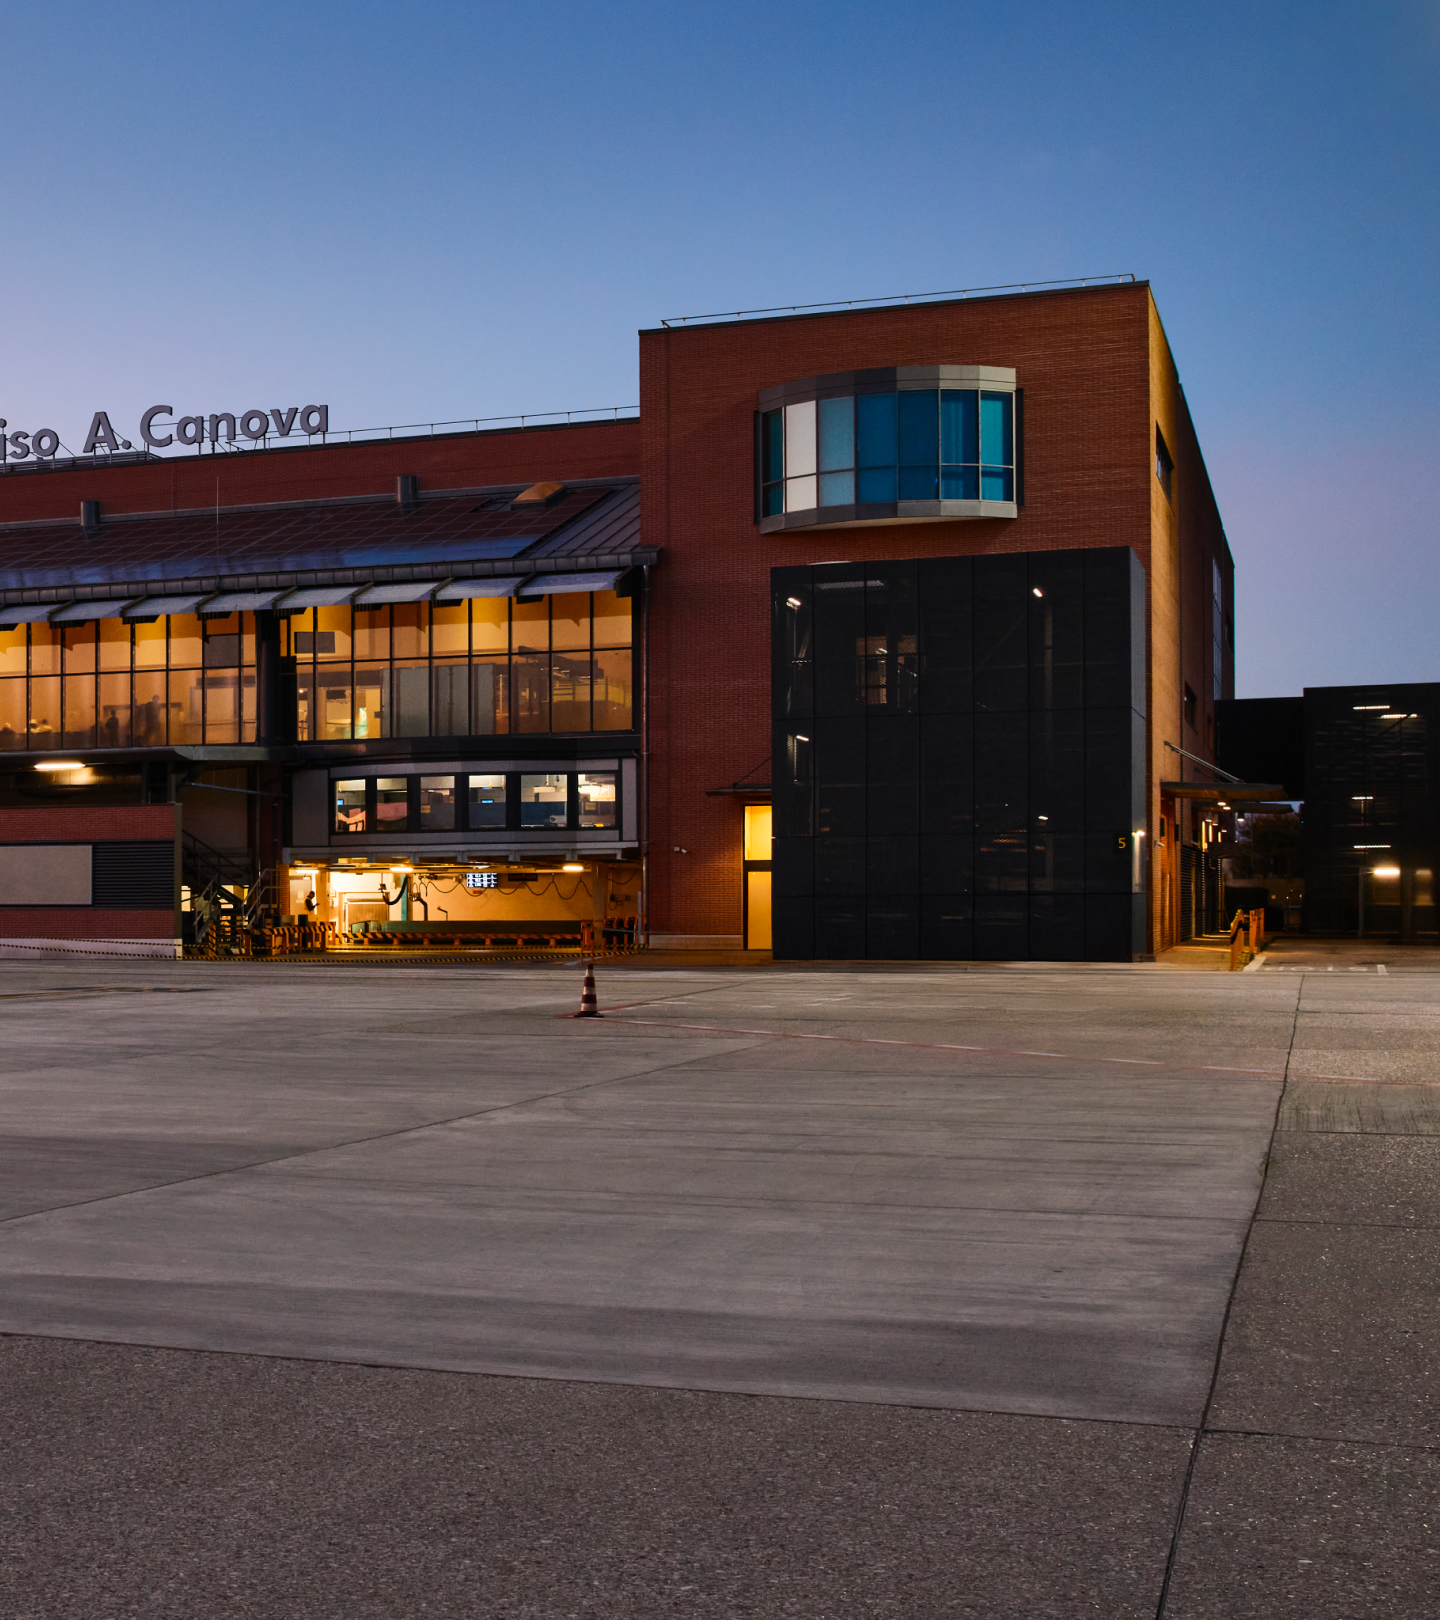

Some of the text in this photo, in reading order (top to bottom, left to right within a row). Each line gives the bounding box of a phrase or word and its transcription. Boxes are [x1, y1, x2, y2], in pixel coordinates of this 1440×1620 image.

[83, 411, 132, 453] A.
[140, 404, 328, 447] Canova
[1119, 837, 1126, 849] 5
